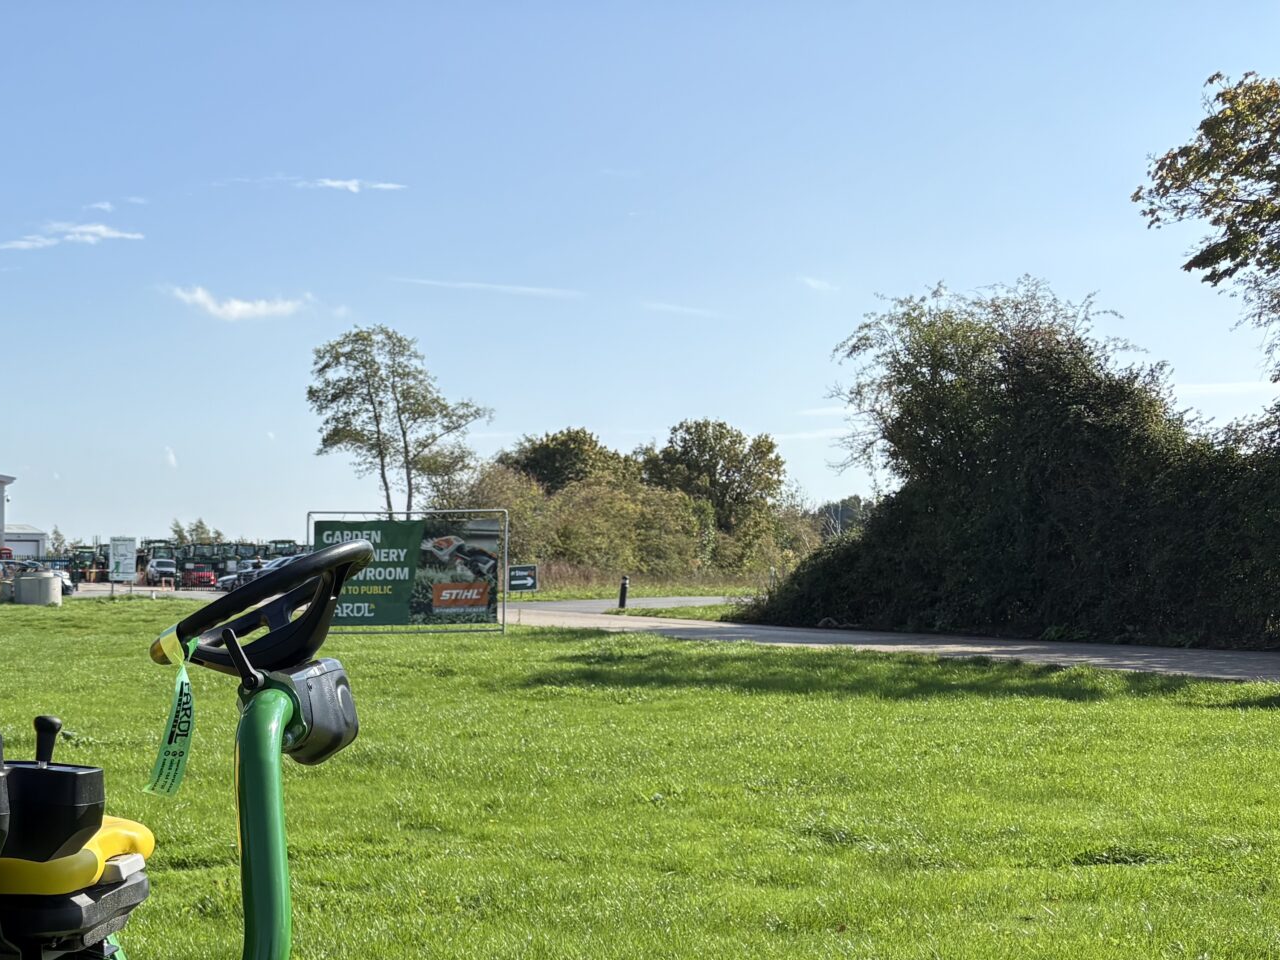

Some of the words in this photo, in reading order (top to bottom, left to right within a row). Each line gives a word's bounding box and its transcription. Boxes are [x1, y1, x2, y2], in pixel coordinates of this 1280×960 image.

[322, 530, 382, 544] GARDEN
[348, 586, 359, 594] TO
[360, 585, 392, 595] PUBLIC
[440, 588, 481, 600] STIHL
[333, 602, 375, 617] AROL
